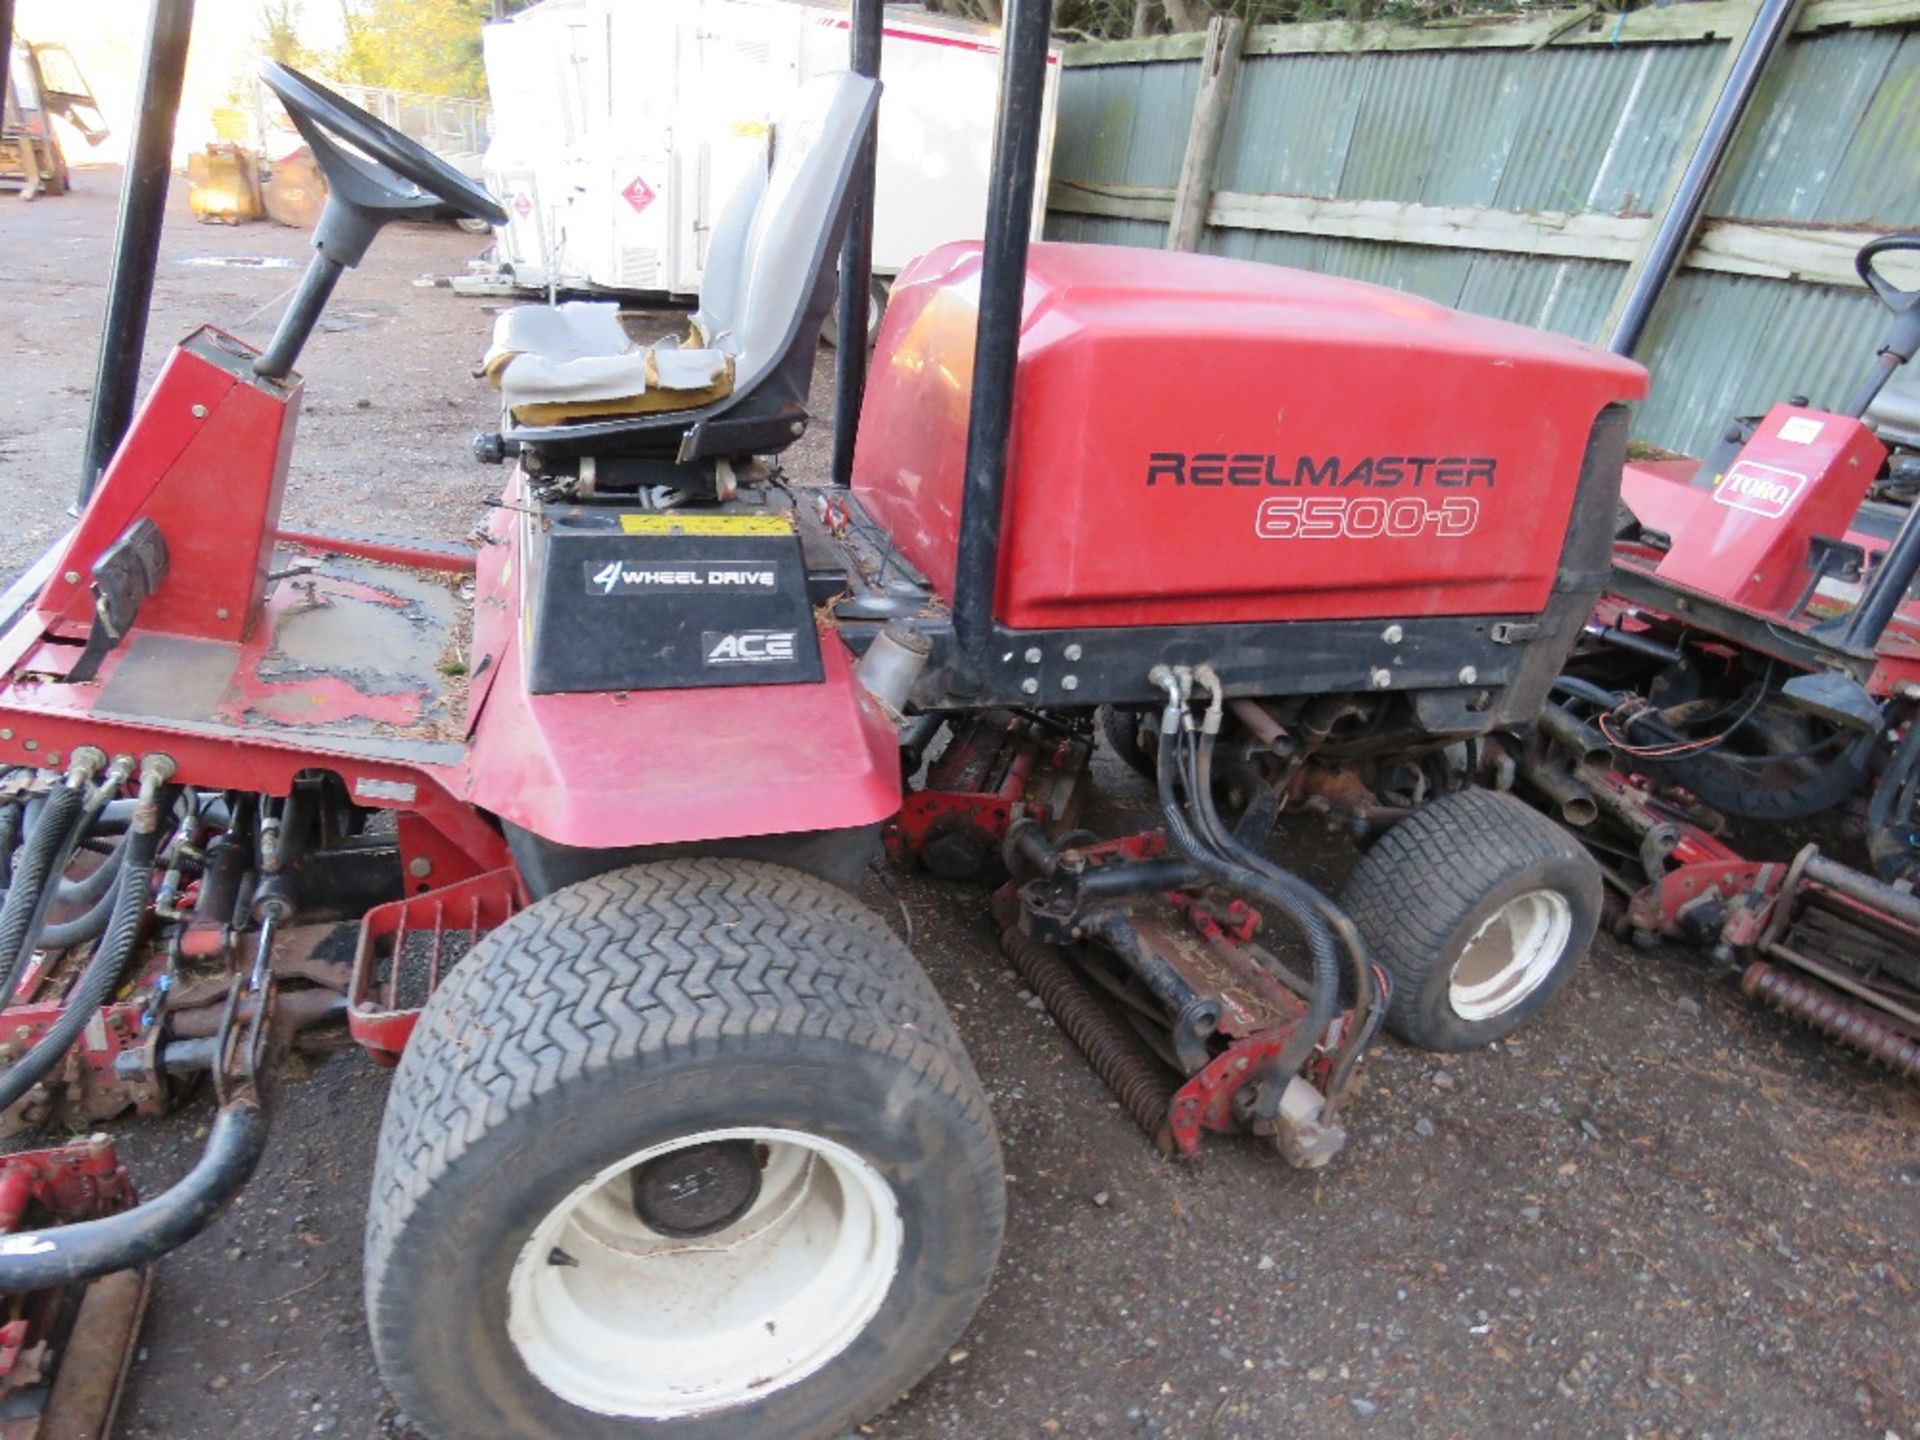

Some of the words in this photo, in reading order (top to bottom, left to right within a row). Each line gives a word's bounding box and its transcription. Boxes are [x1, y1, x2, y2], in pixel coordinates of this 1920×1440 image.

[1146, 452, 1497, 488] REELMASTER
[1728, 473, 1789, 505] TORO
[1255, 497, 1480, 539] 6500-D
[592, 560, 623, 595] 4
[622, 571, 703, 585] WHEEL
[708, 571, 775, 587] DRIVE
[708, 633, 796, 658] ACE
